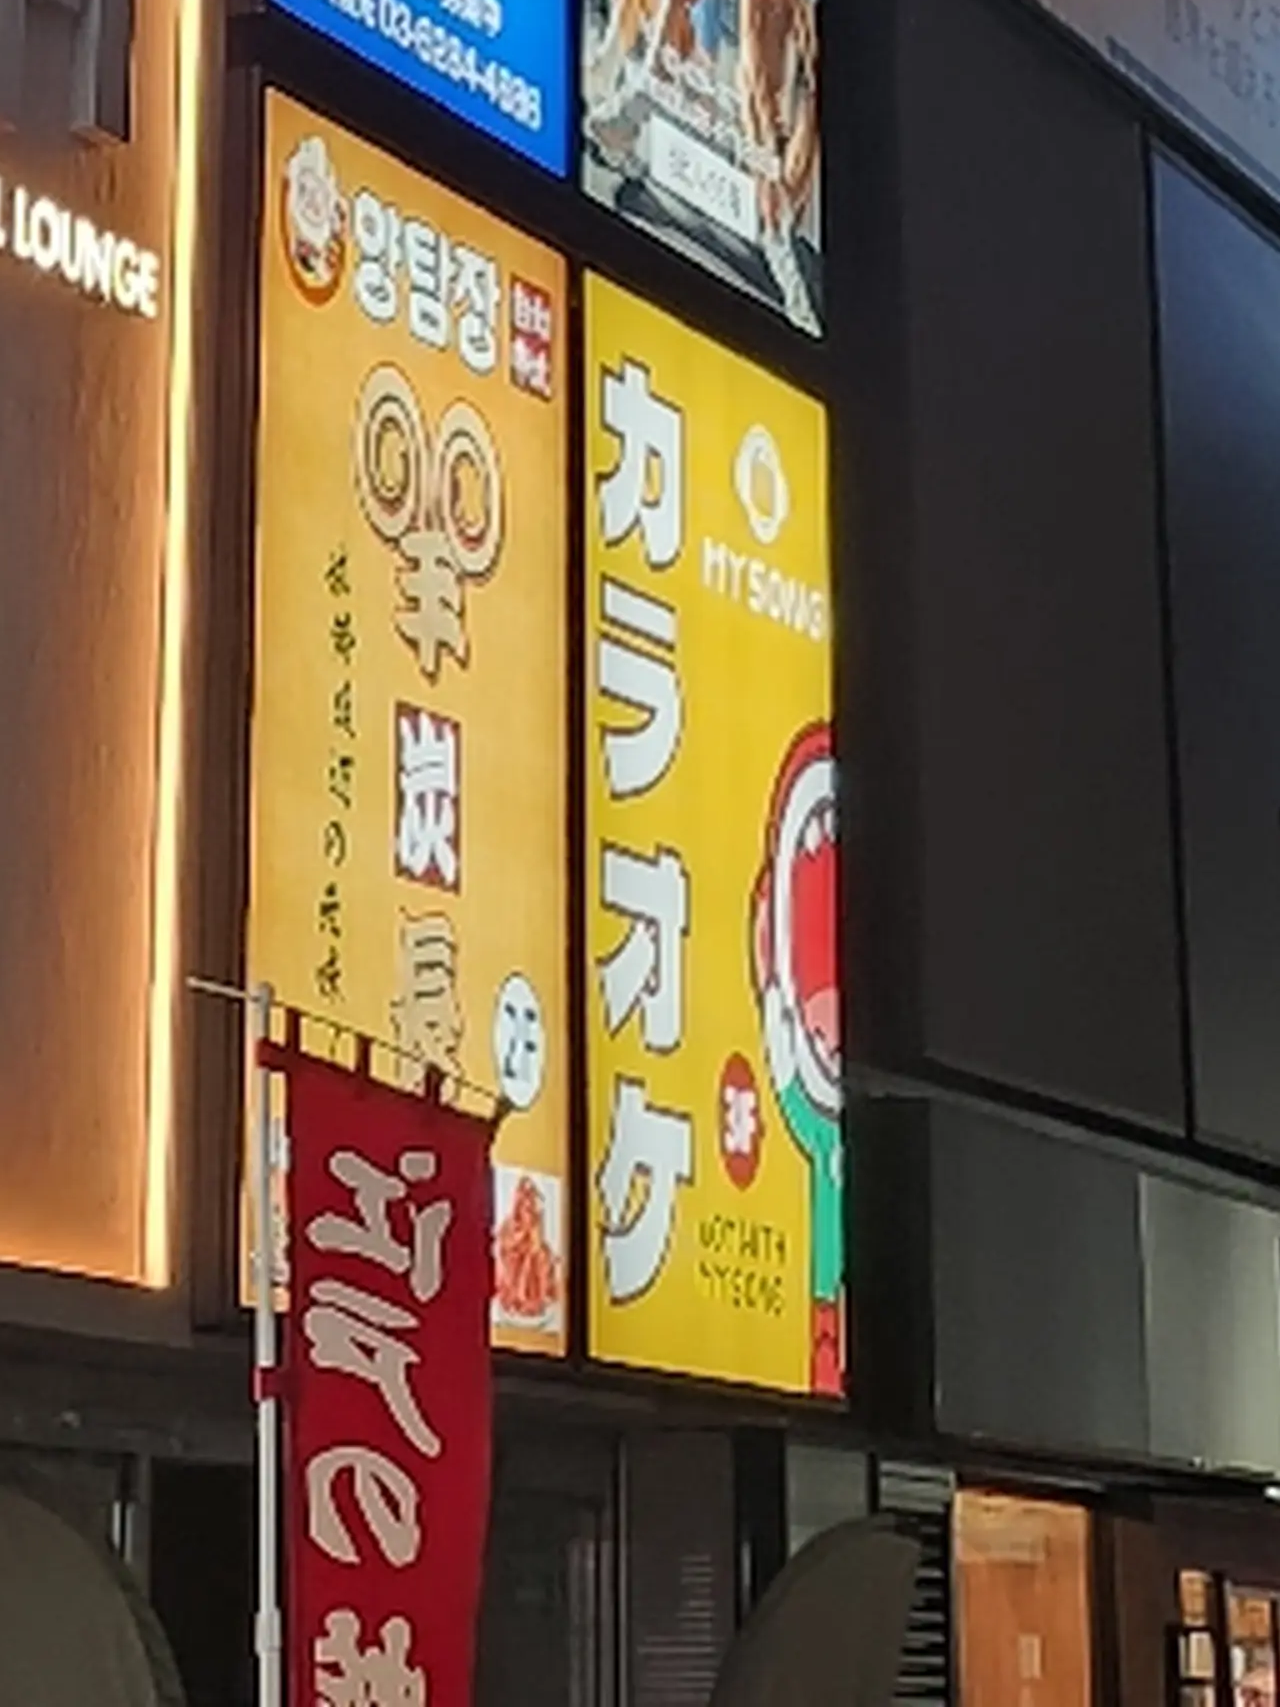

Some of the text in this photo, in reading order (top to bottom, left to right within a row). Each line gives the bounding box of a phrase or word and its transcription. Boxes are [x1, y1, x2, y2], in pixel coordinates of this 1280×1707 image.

[13, 185, 161, 320] LOUNGE
[597, 355, 694, 1309] カラオケ
[721, 1086, 758, 1154] 3F
